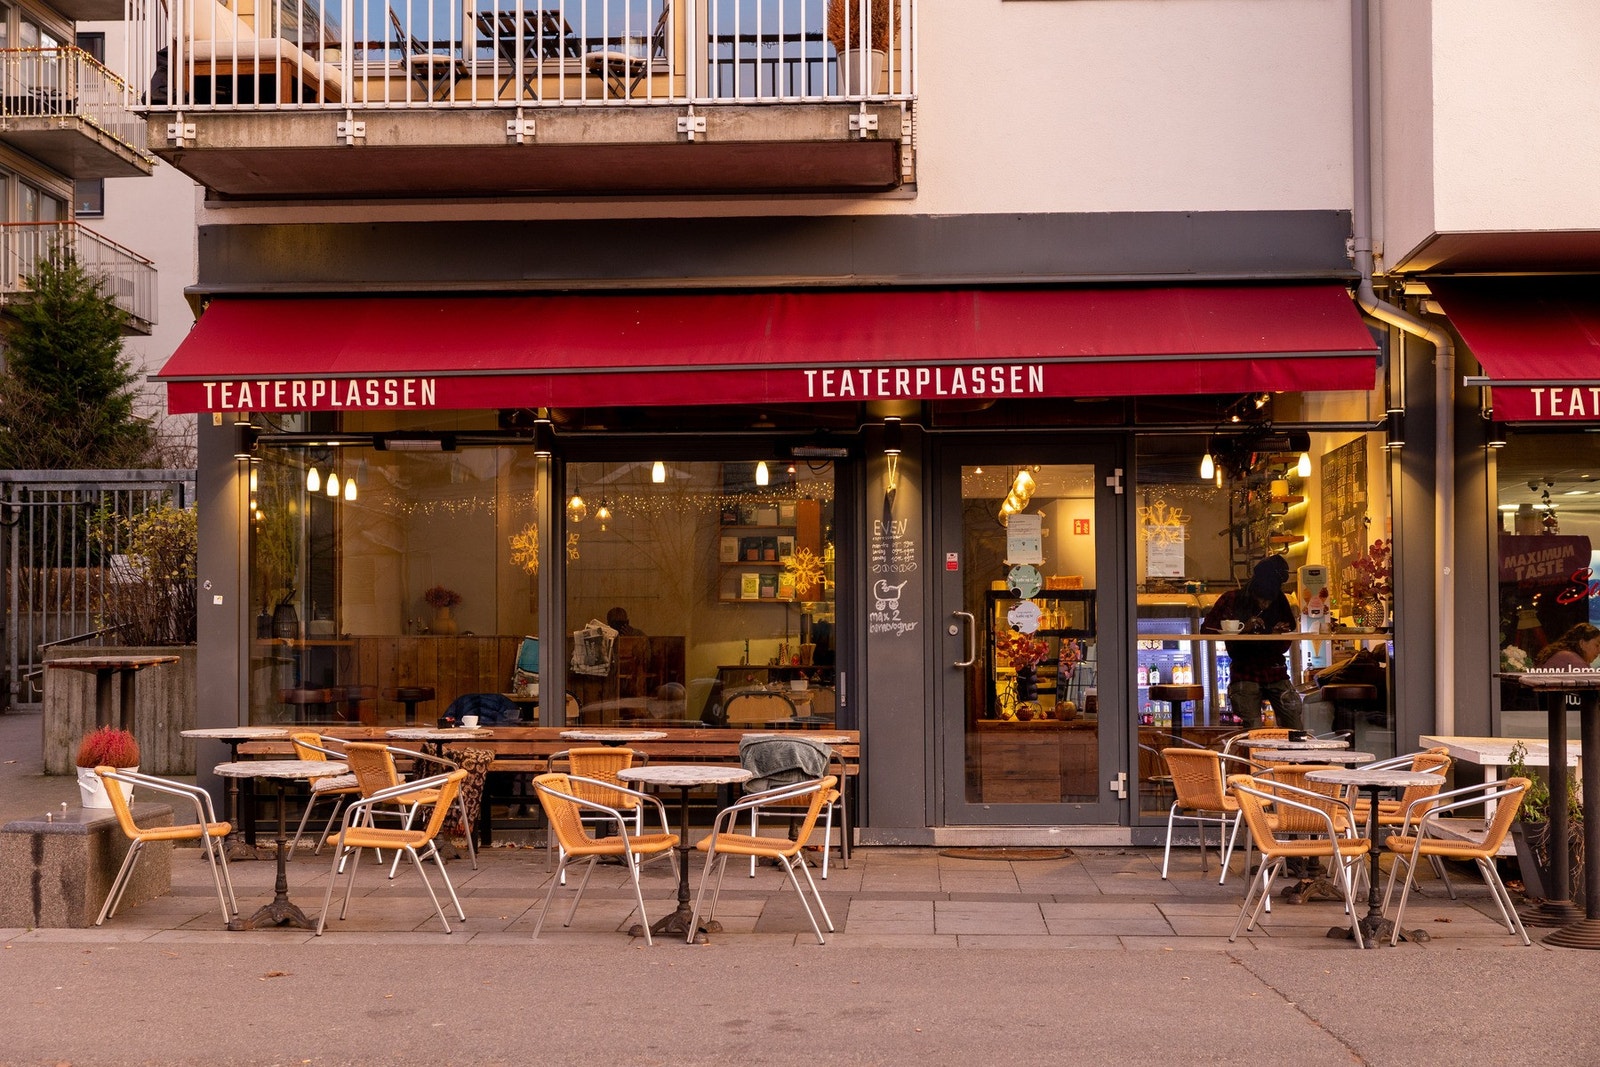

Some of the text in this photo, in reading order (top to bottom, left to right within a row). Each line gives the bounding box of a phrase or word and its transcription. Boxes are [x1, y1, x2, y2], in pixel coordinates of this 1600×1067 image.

[804, 365, 1044, 397] TEATERPLASSEN
[203, 379, 436, 409] TEATERPLASSEN
[1530, 387, 1600, 416] TEAT
[873, 519, 908, 536] EVEN
[1504, 544, 1575, 569] MAXIMUM
[1515, 558, 1564, 581] TASTE
[892, 609, 902, 621] 2
